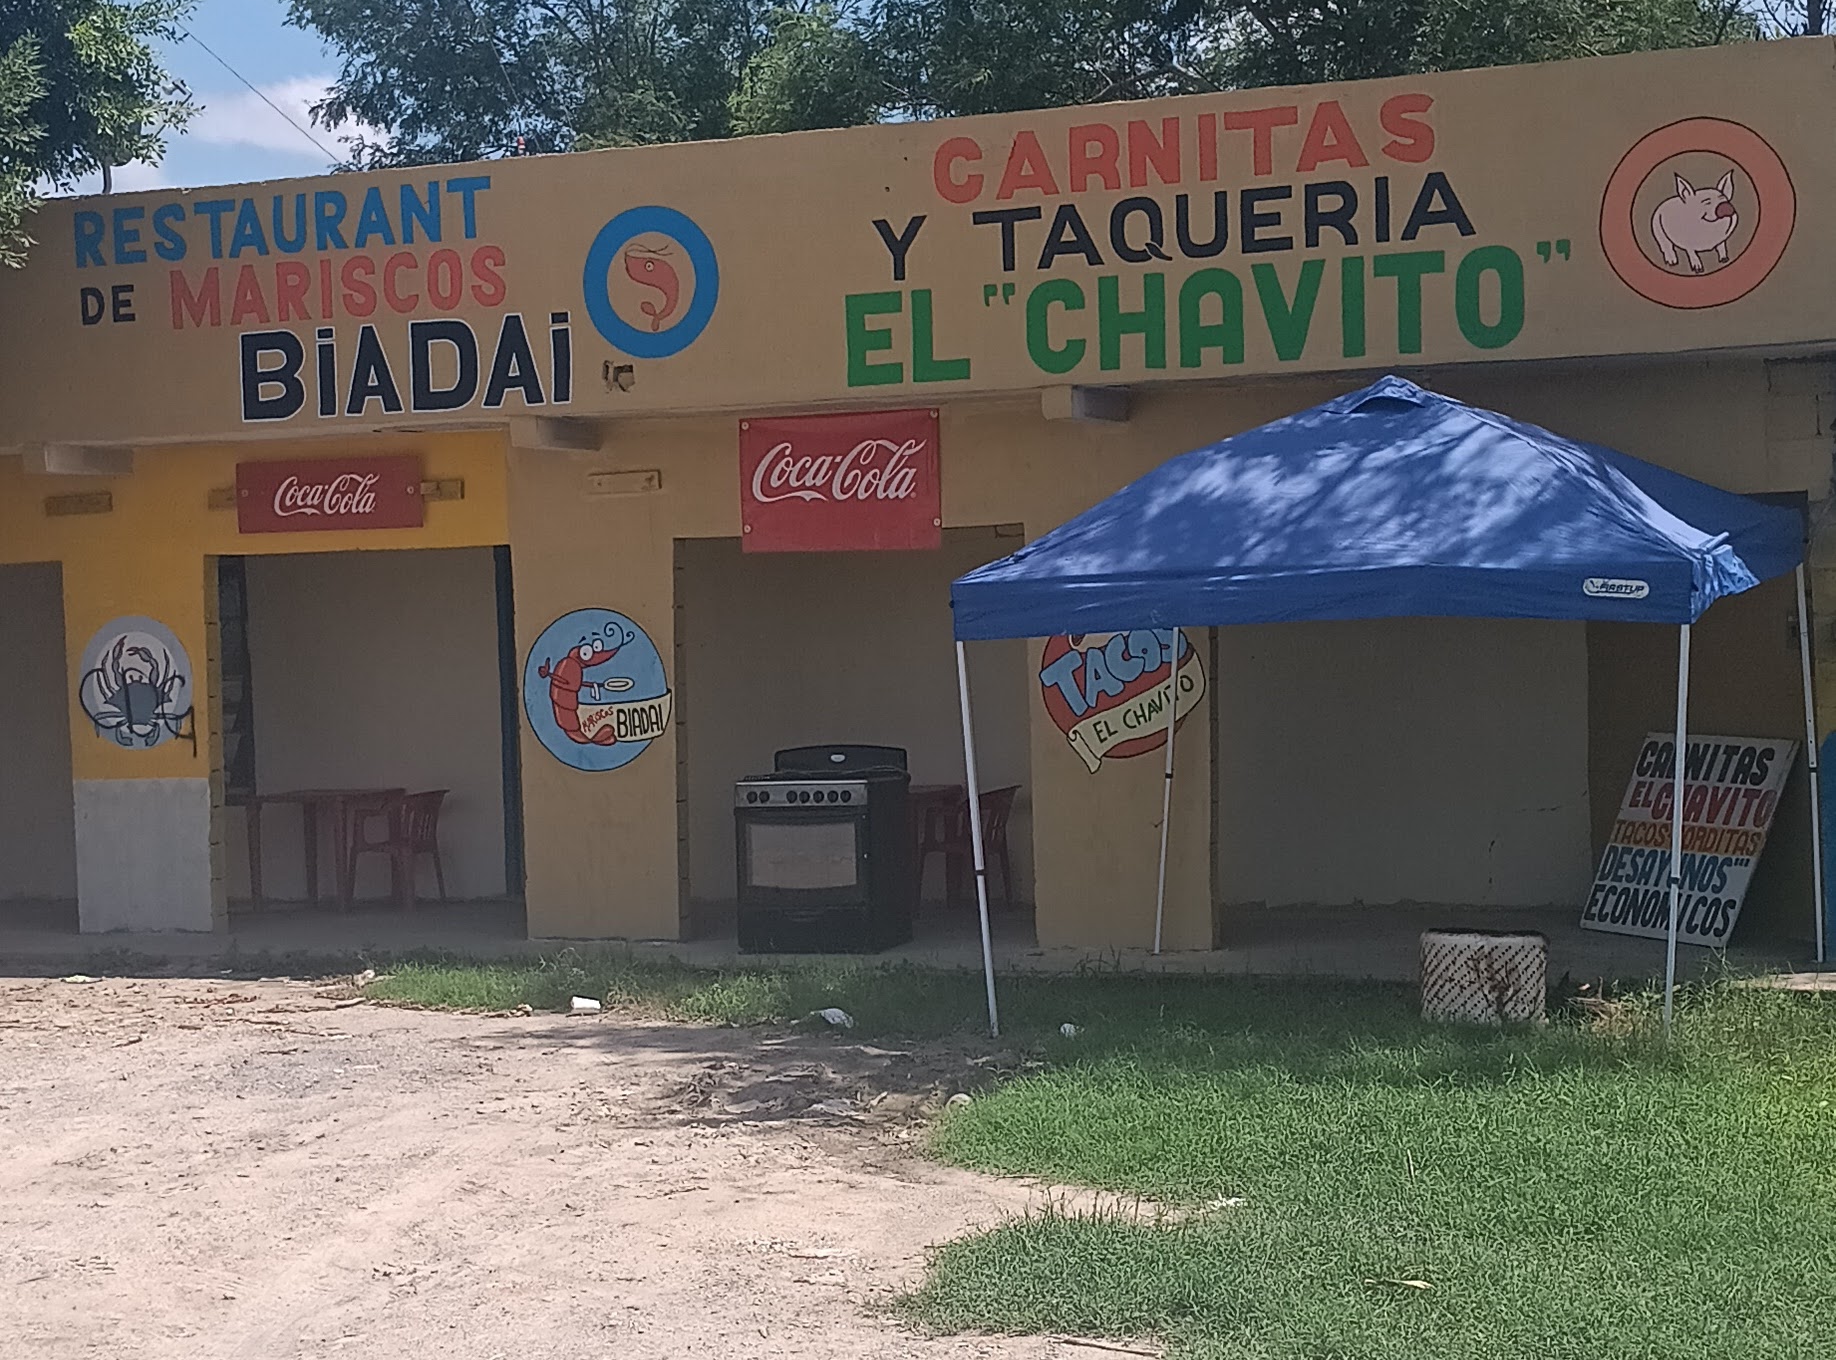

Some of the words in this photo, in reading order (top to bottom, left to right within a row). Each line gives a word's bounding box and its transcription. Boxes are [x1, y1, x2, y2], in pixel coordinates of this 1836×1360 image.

[933, 93, 1436, 204] CARNITAS
[74, 175, 492, 268] RESTAURANT
[872, 215, 927, 281] Y
[973, 171, 1476, 271] TAQUERIA
[81, 284, 136, 326] DE
[170, 245, 507, 329] MARISCOS
[845, 288, 971, 387] EL
[274, 474, 380, 516] Coca-Cola
[752, 439, 927, 503] Coca-Cola
[1039, 629, 1189, 717] TACOS
[616, 703, 665, 738] BIADAI
[1093, 720, 1118, 743] EL
[1629, 781, 1653, 808] EL
[1676, 827, 1762, 856] ORDITAS
